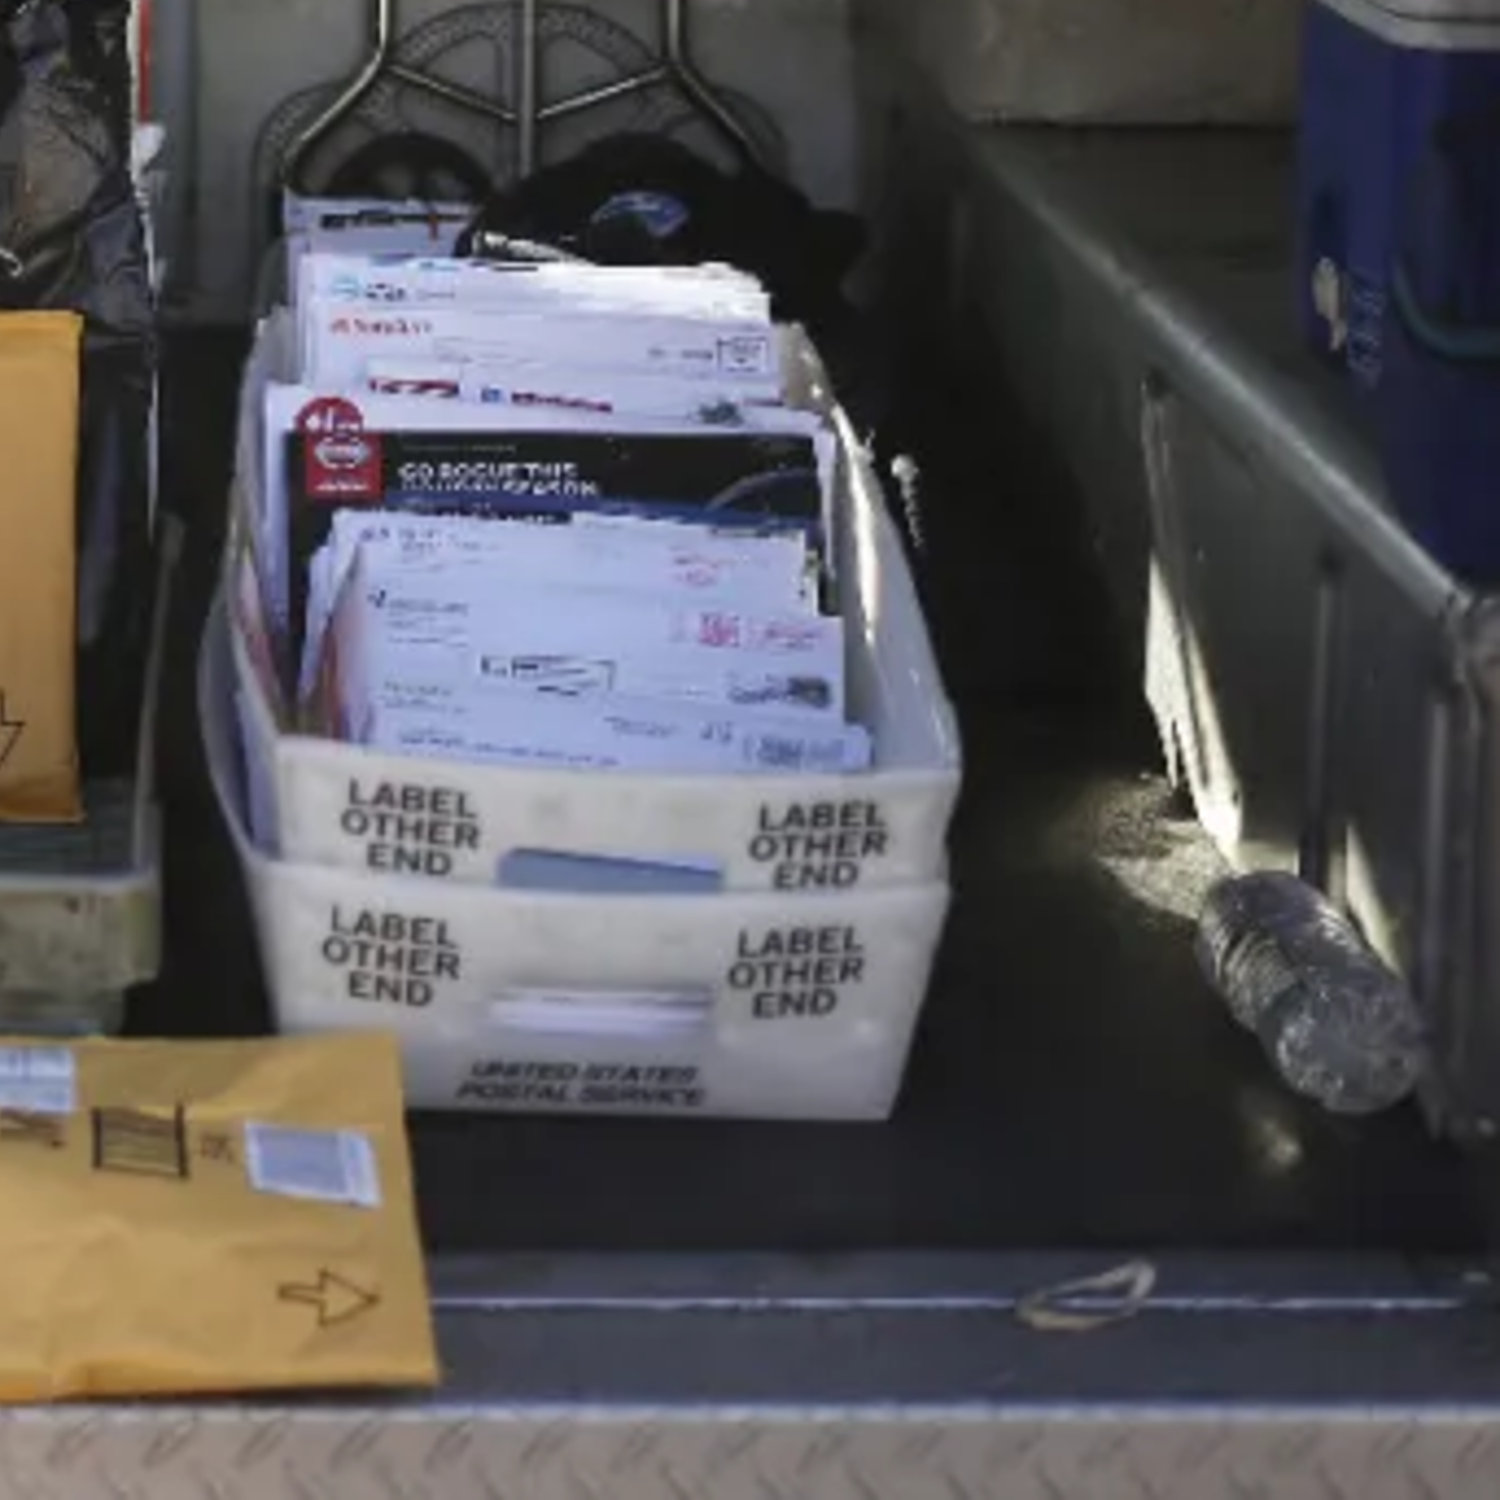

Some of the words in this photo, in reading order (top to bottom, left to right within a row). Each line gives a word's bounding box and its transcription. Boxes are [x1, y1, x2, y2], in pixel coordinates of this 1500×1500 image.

[348, 775, 479, 820] LABEL
[340, 806, 480, 850] OTHER
[759, 802, 887, 832] LABEL
[366, 842, 453, 877] END
[748, 830, 888, 862] OTHER
[772, 860, 859, 890] END
[330, 903, 461, 950] LABEL
[737, 926, 865, 960] LABEL
[321, 934, 461, 981] OTHER
[727, 958, 865, 990] OTHER
[348, 970, 435, 1008] END
[752, 987, 839, 1019] END
[469, 1060, 579, 1080] UNITED
[582, 1063, 701, 1084] STATES
[453, 1079, 569, 1103] POSTAL
[579, 1085, 707, 1108] SERVICE
